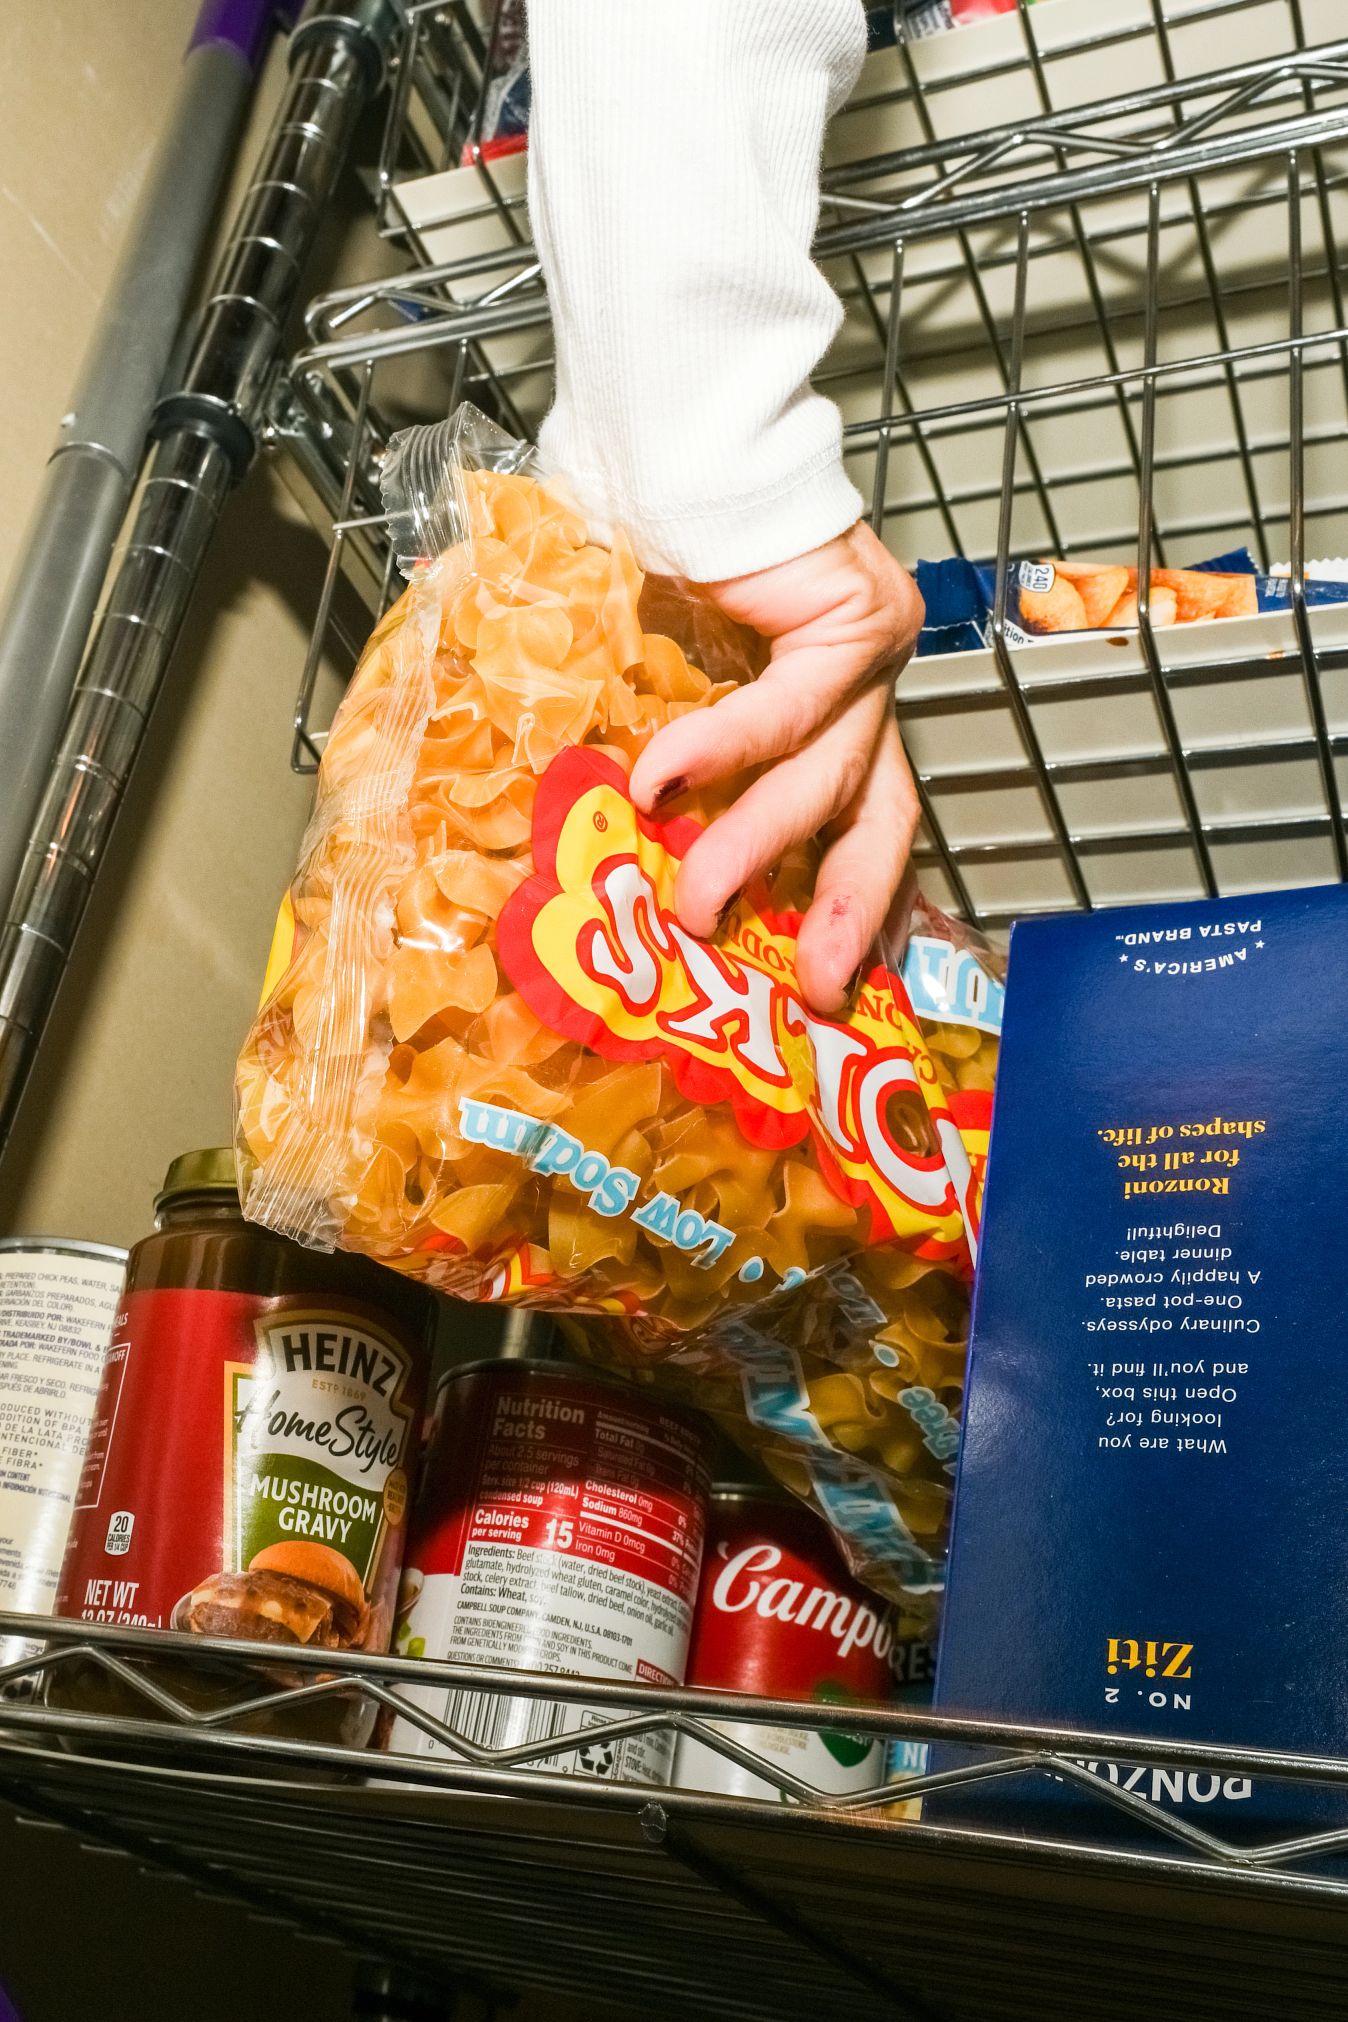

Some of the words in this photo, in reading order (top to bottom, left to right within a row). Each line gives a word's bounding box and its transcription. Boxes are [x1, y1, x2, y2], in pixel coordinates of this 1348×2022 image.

[1033, 568, 1049, 589] 240
[1199, 920, 1262, 937] PASTA
[1133, 947, 1248, 975] AMERICA'S
[1097, 1127, 1142, 1146] life.
[1146, 1125, 1174, 1144] of
[1180, 1117, 1266, 1139] shapes
[1118, 1154, 1157, 1171] the
[1164, 1152, 1194, 1170] all
[1200, 1150, 1240, 1167] for
[1124, 1177, 1230, 1200] Ronzoni
[632, 1192, 736, 1270] Low
[1127, 1223, 1221, 1240] Delightful!
[1115, 1249, 1165, 1263] table.
[1172, 1248, 1232, 1261] dinner
[1086, 1273, 1163, 1287] crowded
[1171, 1269, 1239, 1285] happily
[1248, 1271, 1261, 1284] A
[1101, 1294, 1156, 1310] pasta.
[1164, 1293, 1242, 1309] One-pot
[1082, 1317, 1173, 1333] odysseys.
[1180, 1317, 1260, 1333] Culinary
[3, 1331, 55, 1343] TRADEMARKED
[281, 1333, 396, 1397] HEINZ
[1088, 1363, 1104, 1376] it.
[1112, 1363, 1145, 1376] find
[1153, 1360, 1204, 1376] you'll
[1213, 1363, 1248, 1376] and
[1095, 1386, 1135, 1401] box,
[1143, 1387, 1177, 1401] this
[1186, 1385, 1236, 1402] Open
[496, 1396, 585, 1424] Nutrition
[1151, 1410, 1222, 1427] looking
[44, 1418, 57, 1427] OF
[61, 1424, 81, 1434] BPA
[1106, 1412, 1143, 1426] for?
[4, 1423, 18, 1431] DE
[21, 1425, 33, 1434] LA
[38, 1428, 63, 1439] LATA
[493, 1417, 546, 1440] Facts
[1099, 1434, 1132, 1448] you
[1140, 1437, 1169, 1449] are
[1177, 1438, 1227, 1454] What
[536, 1449, 580, 1468] servings
[250, 1474, 376, 1523] MUSHROOM
[531, 1481, 546, 1493] cup
[547, 1481, 579, 1500] (120mL)
[585, 1480, 637, 1504] Cholesterol
[638, 1496, 653, 1513] 0mg
[523, 1494, 544, 1507] soup
[475, 1509, 529, 1529] Calories
[582, 1497, 617, 1516] Sodium
[618, 1507, 643, 1527] 860mg
[114, 1516, 129, 1533] 20
[279, 1507, 352, 1543] GRAVY
[108, 1534, 130, 1542] CALORIES
[472, 1527, 487, 1538] per
[488, 1528, 522, 1542] serving
[546, 1519, 573, 1549] 15
[579, 1521, 612, 1540] Vitamin
[615, 1531, 622, 1543] D
[623, 1535, 646, 1554] 0mcg
[575, 1540, 593, 1554] Iron
[596, 1545, 616, 1562] 0mg
[468, 1545, 515, 1559] Ingredients:
[516, 1549, 535, 1561] Beef
[559, 1554, 585, 1575] (water,
[588, 1565, 608, 1580] dried
[609, 1570, 625, 1583] beef
[465, 1558, 504, 1572] glutamate,
[506, 1561, 550, 1578] hydrolyzed
[551, 1570, 575, 1585] wheat
[577, 1576, 603, 1593] gluten,
[605, 1585, 633, 1600] caramel
[84, 1579, 113, 1606] NET
[113, 1581, 140, 1609] WT
[461, 1583, 496, 1596] Contains:
[499, 1586, 527, 1602] Wheat,
[463, 1571, 483, 1582] stock,
[485, 1573, 507, 1587] celery
[560, 1586, 586, 1602] tallow,
[588, 1592, 607, 1607] dried
[627, 1606, 645, 1620] onion
[454, 1616, 481, 1626] CONTAINS
[457, 1600, 487, 1612] CAMPBELL
[490, 1604, 506, 1614] SOUP
[603, 1628, 633, 1647] 08103-1701
[450, 1636, 466, 1645] FROM
[467, 1636, 507, 1651] GENETICALLY
[453, 1626, 463, 1635] THE
[464, 1626, 503, 1640] INGREDIENTS
[504, 1632, 523, 1643] FROM
[556, 1643, 568, 1653] SOY
[570, 1645, 576, 1655] IN
[578, 1648, 592, 1659] THIS
[592, 1652, 618, 1668] PRODUCT
[447, 1651, 475, 1661] QUESTIONS
[1107, 1638, 1194, 1679] Ziti
[1105, 1688, 1119, 1703] 2
[1137, 1691, 1191, 1710] NO.
